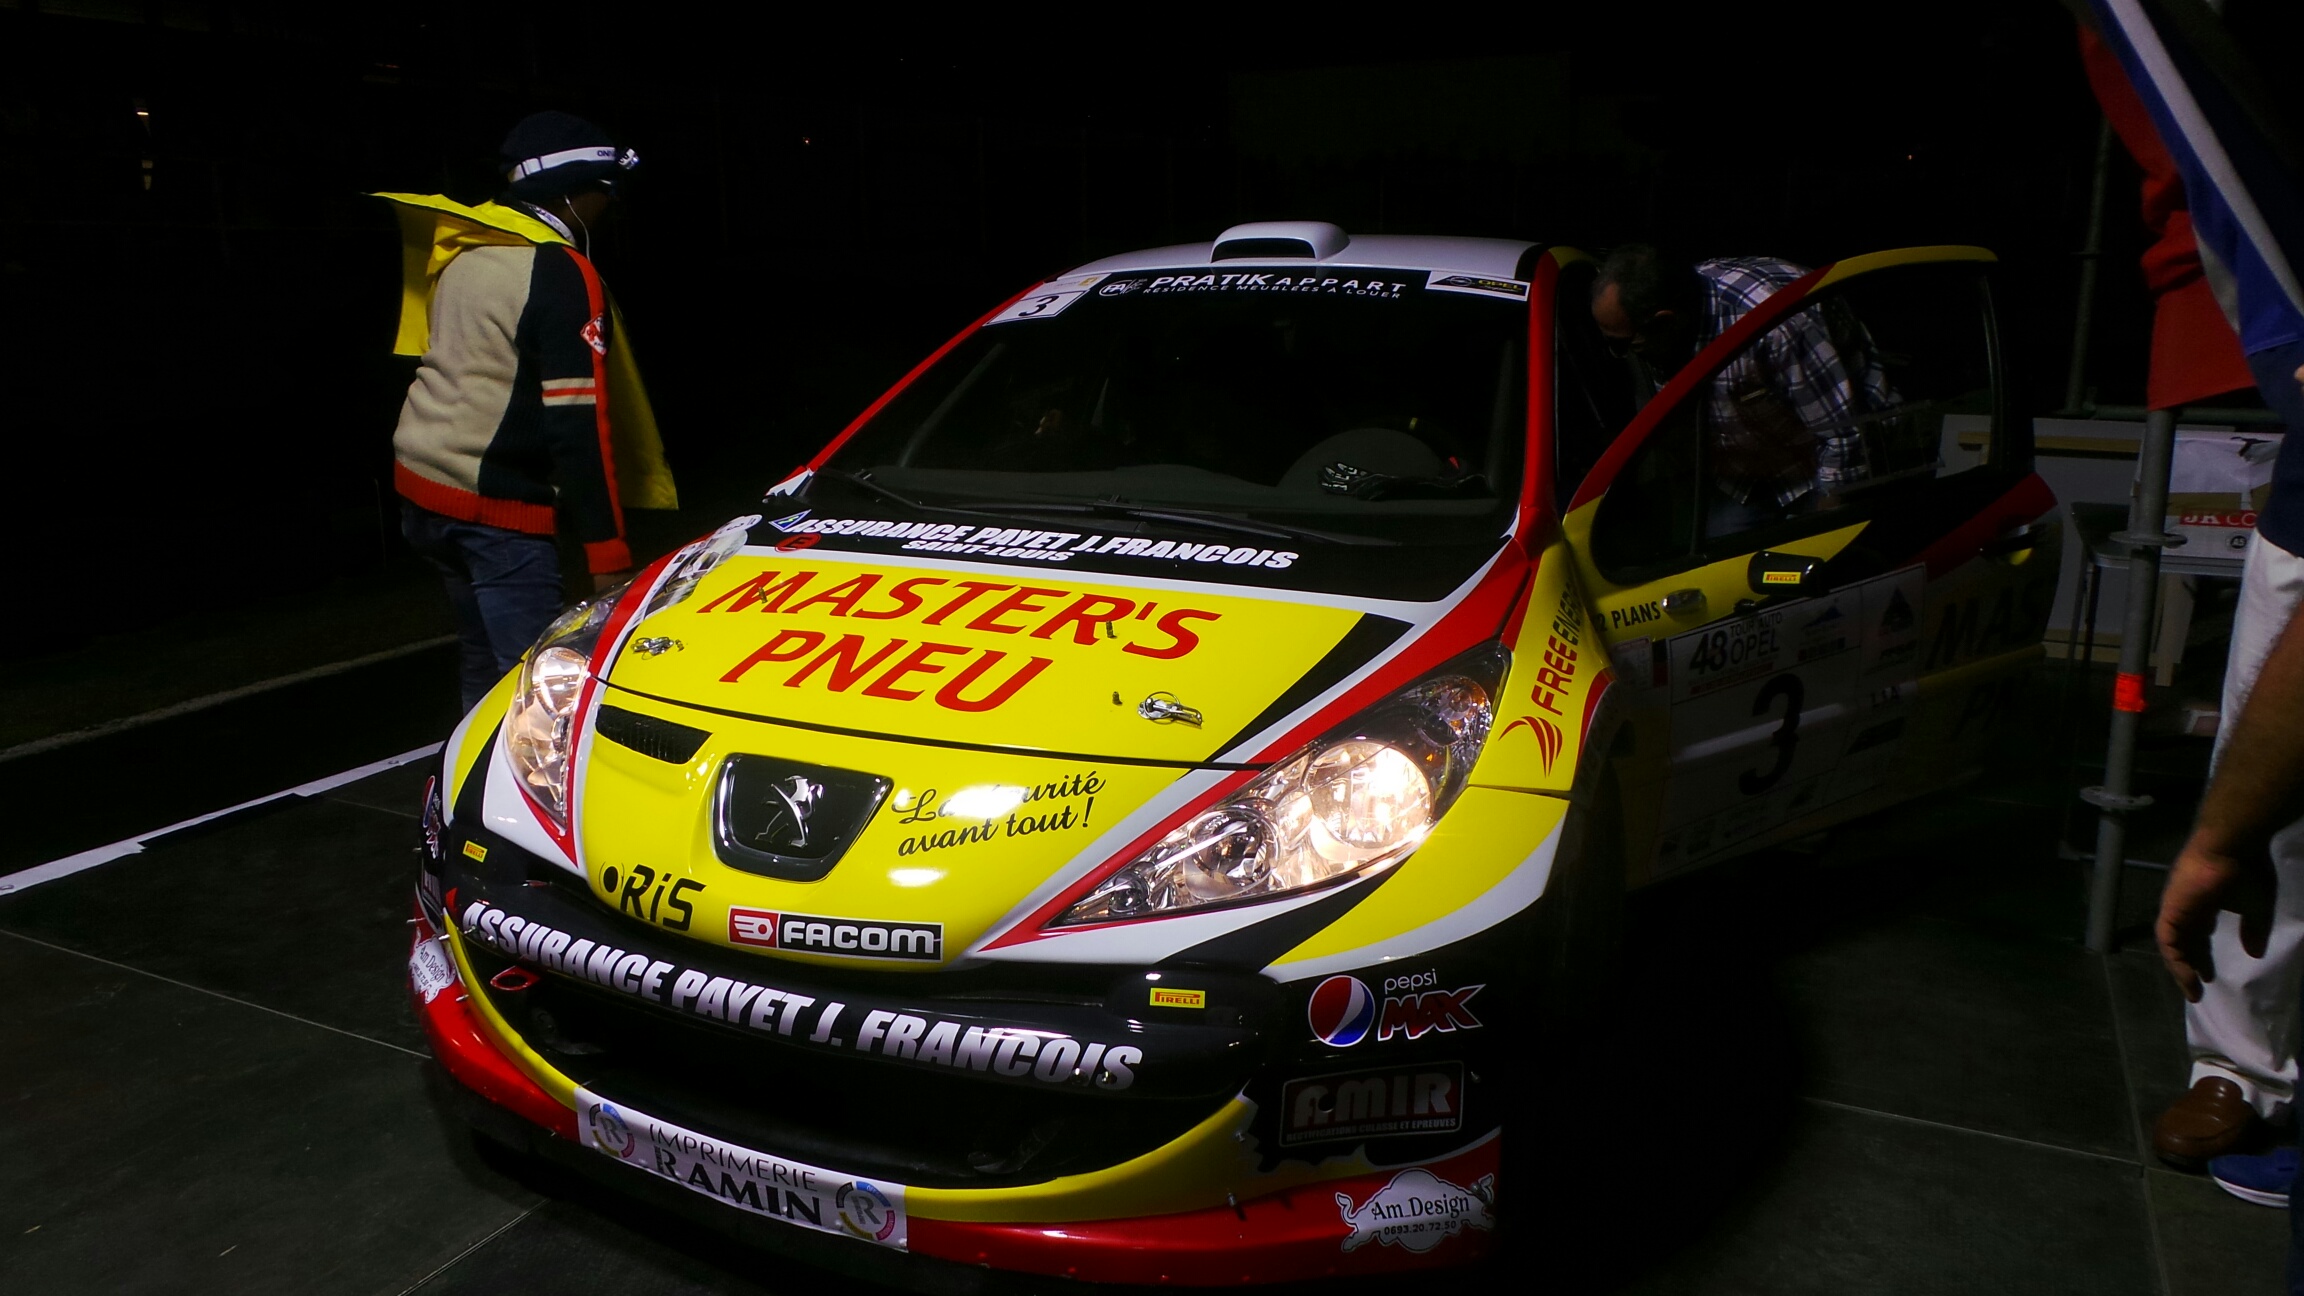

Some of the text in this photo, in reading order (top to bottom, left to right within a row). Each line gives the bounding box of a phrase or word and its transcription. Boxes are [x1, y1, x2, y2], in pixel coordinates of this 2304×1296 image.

[1018, 295, 1060, 317] 3
[1346, 289, 1401, 299] LOUER
[900, 539, 1076, 562] SAINT-LOUIS
[968, 524, 1081, 550] PAYET
[696, 571, 1222, 660] MASTER'S
[1611, 600, 1662, 629] PLANS
[1689, 630, 1728, 675] 48
[1730, 628, 1780, 665] OPEL
[718, 628, 1054, 713] PNEU
[1738, 673, 1804, 796] 3
[898, 817, 999, 857] avant
[783, 920, 935, 954] FACOM
[463, 901, 1144, 1090] ASSURANCE PAYET J. FRANCOIS
[1155, 991, 1201, 1006] PIRELLI
[1384, 968, 1438, 995] pepsi
[1377, 983, 1488, 1042] MAX
[650, 1123, 819, 1192] IMPRIMERIE
[654, 1145, 822, 1226] RAMIN
[1384, 1220, 1457, 1236] 0693.20.72.50
